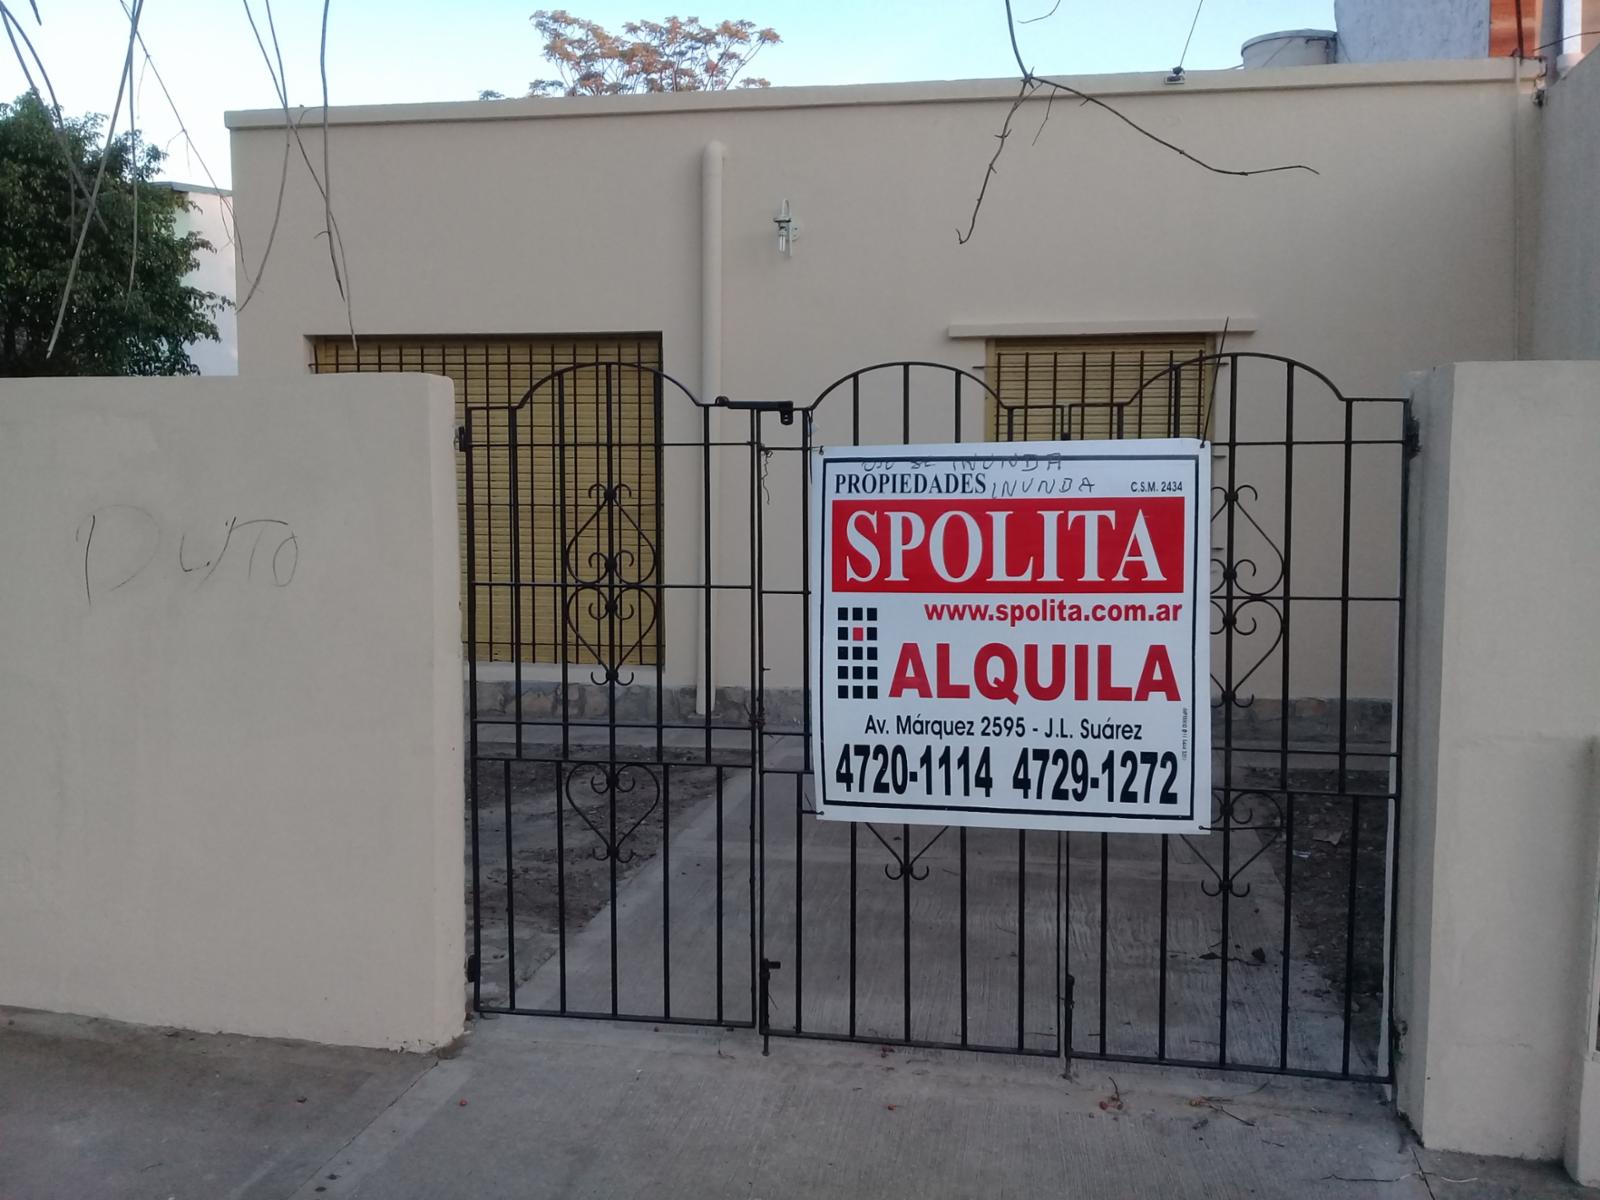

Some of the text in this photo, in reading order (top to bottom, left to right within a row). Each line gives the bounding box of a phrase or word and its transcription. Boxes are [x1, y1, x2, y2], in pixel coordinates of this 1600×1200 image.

[834, 473, 987, 495] PROPIEDADES
[991, 476, 1096, 499] INUNDA
[1130, 480, 1184, 493] C.S.M. 2434
[845, 508, 1168, 583] SPOLITA
[923, 599, 1183, 627] www.spolita.com.ar
[888, 642, 1182, 705] ALQUILA
[864, 714, 890, 735] Av.
[896, 713, 975, 741] Márquez
[980, 716, 1026, 738] 2595
[1044, 721, 1074, 739] J.L.
[1080, 718, 1143, 741] Suárez
[835, 743, 1179, 805] 4720-1114 4729-1272
